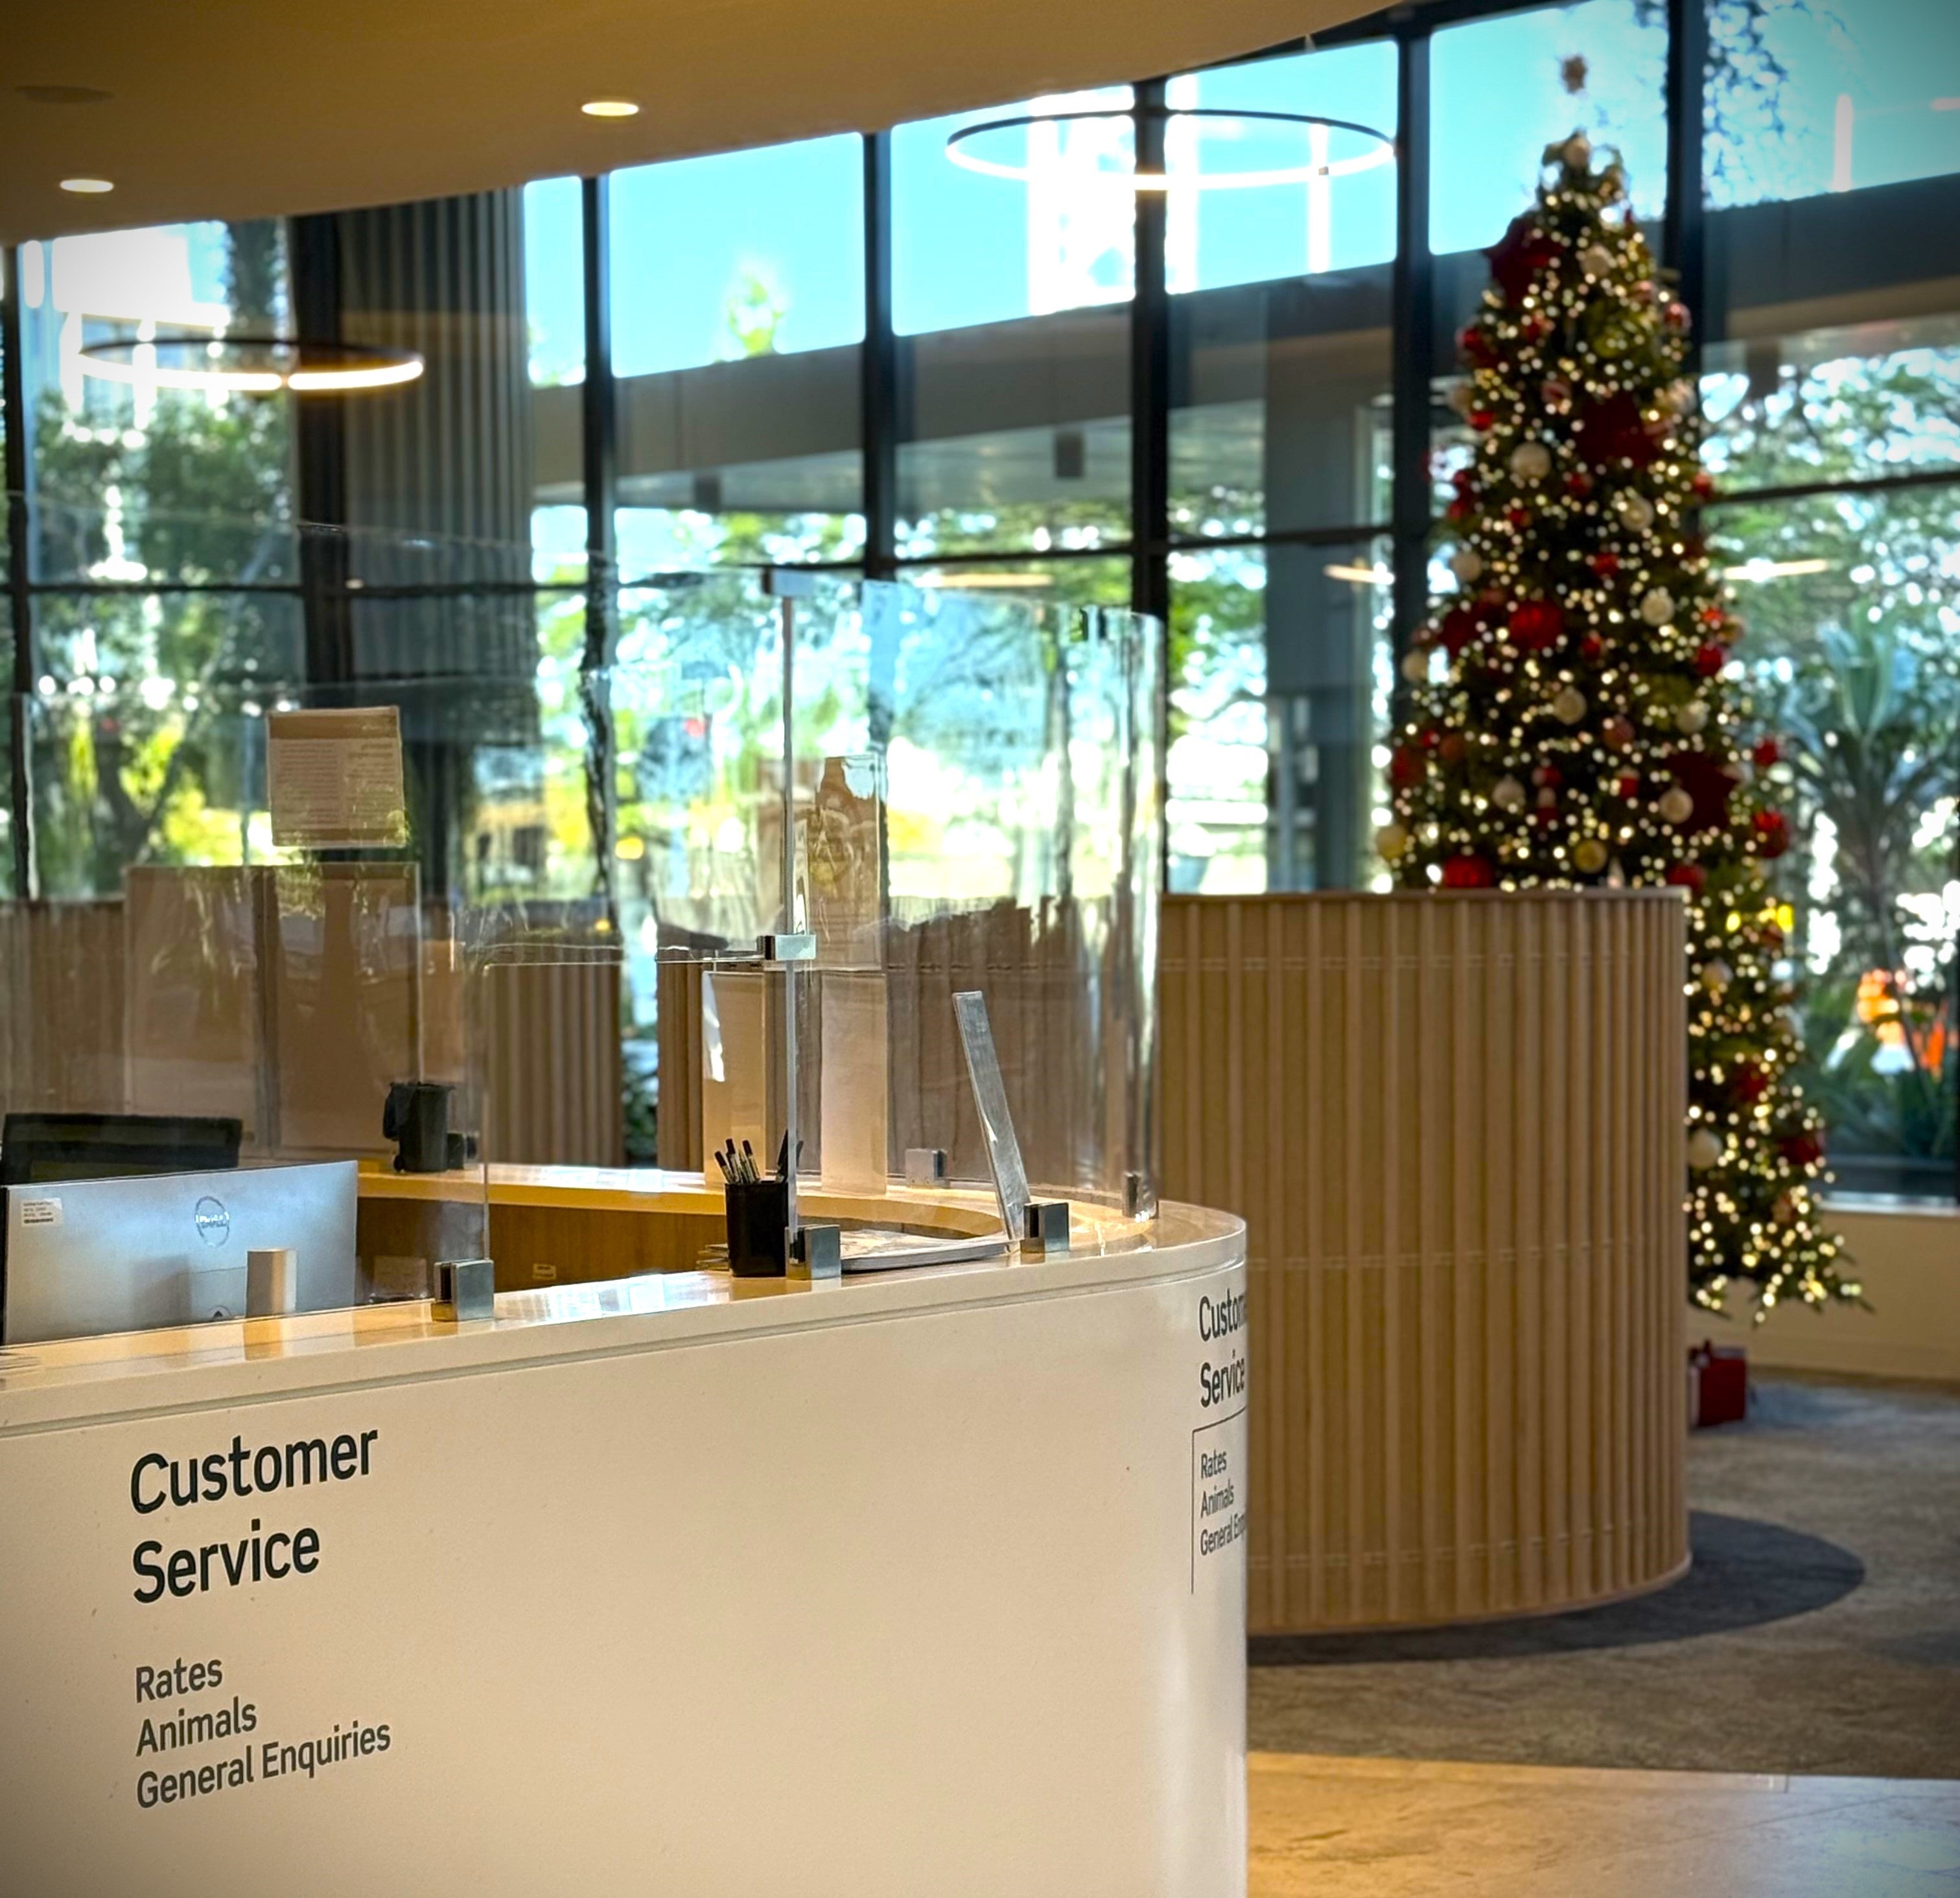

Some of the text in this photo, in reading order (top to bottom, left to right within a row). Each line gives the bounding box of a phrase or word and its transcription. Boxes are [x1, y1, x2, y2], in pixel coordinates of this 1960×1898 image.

[1200, 1348, 1245, 1407] Service
[130, 1429, 378, 1514] Customer
[1201, 1449, 1227, 1479] Rates
[1200, 1478, 1235, 1519] Animals
[132, 1518, 320, 1604] Service
[1200, 1514, 1233, 1556] General
[135, 1657, 223, 1703] Rates
[135, 1696, 257, 1757] Animals
[136, 1720, 391, 1808] General Enquiries
